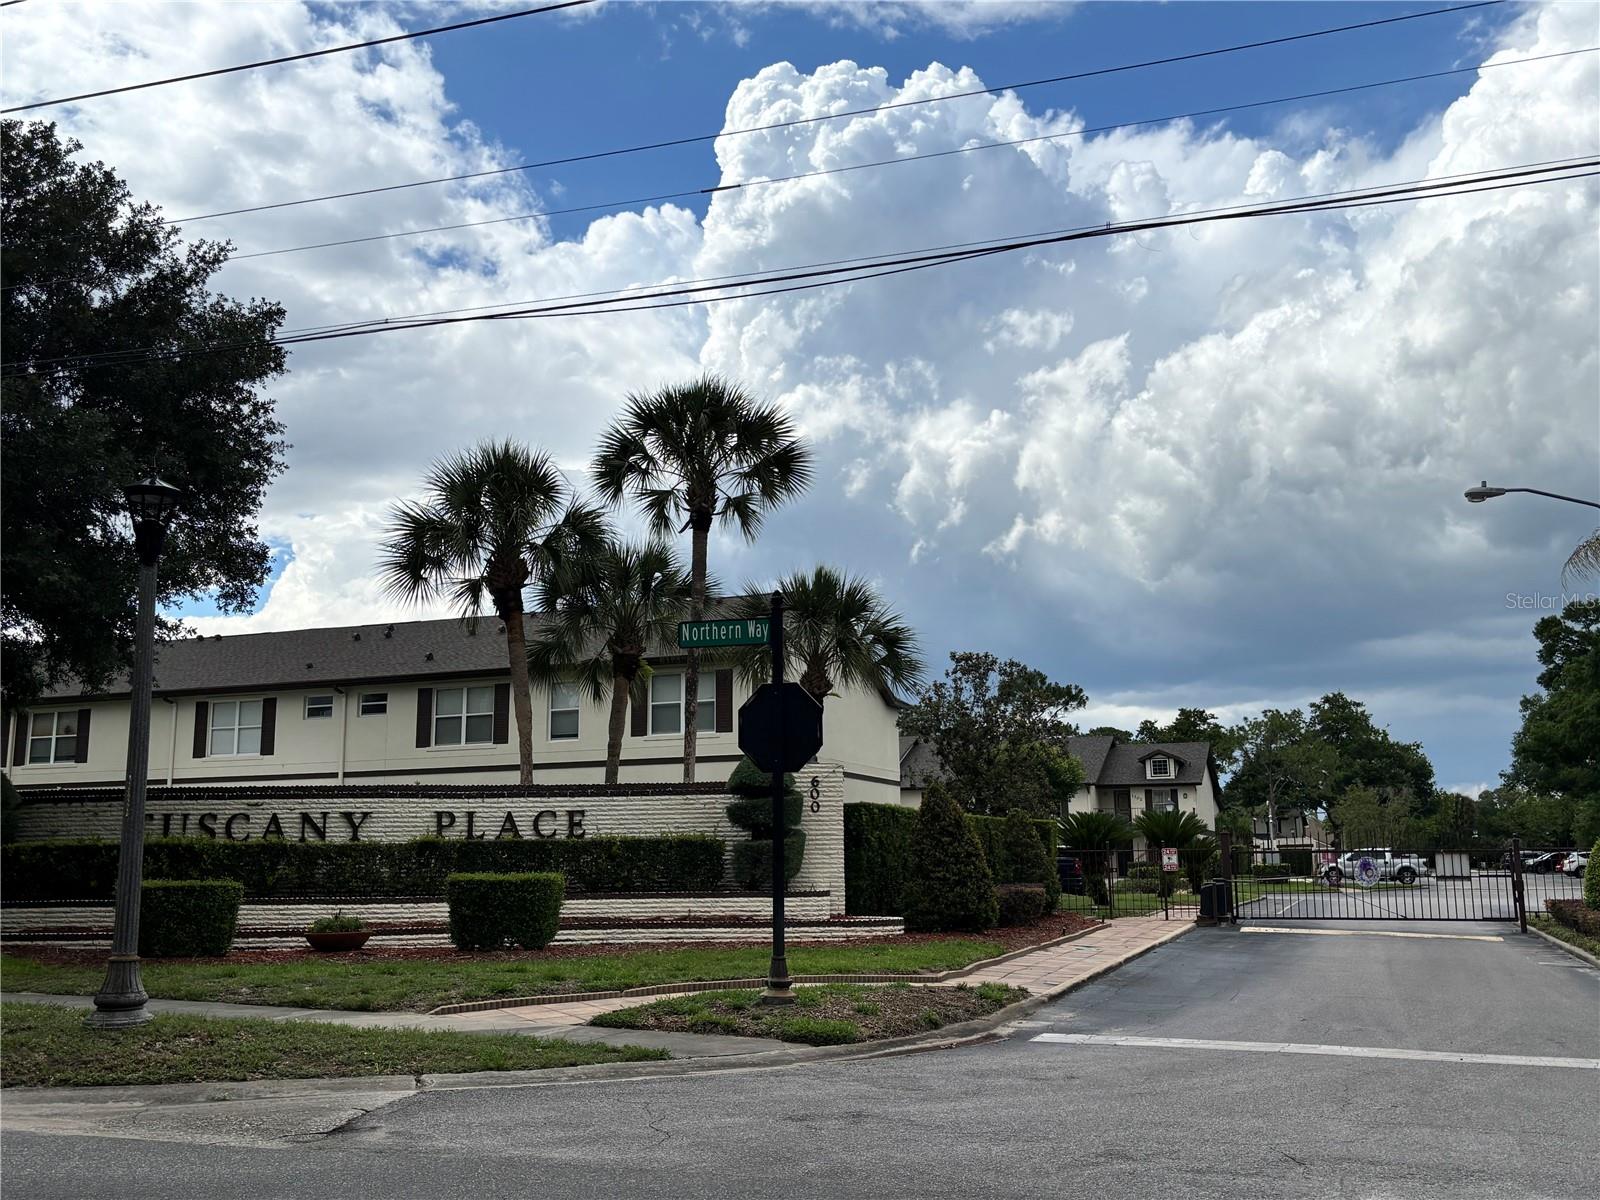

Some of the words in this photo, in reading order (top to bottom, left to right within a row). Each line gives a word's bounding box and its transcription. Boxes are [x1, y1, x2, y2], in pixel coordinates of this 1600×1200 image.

[682, 623, 742, 641] Northern
[747, 620, 769, 642] Way
[810, 775, 820, 813] 600
[146, 812, 373, 842] USCANY
[434, 810, 586, 840] PLACE
